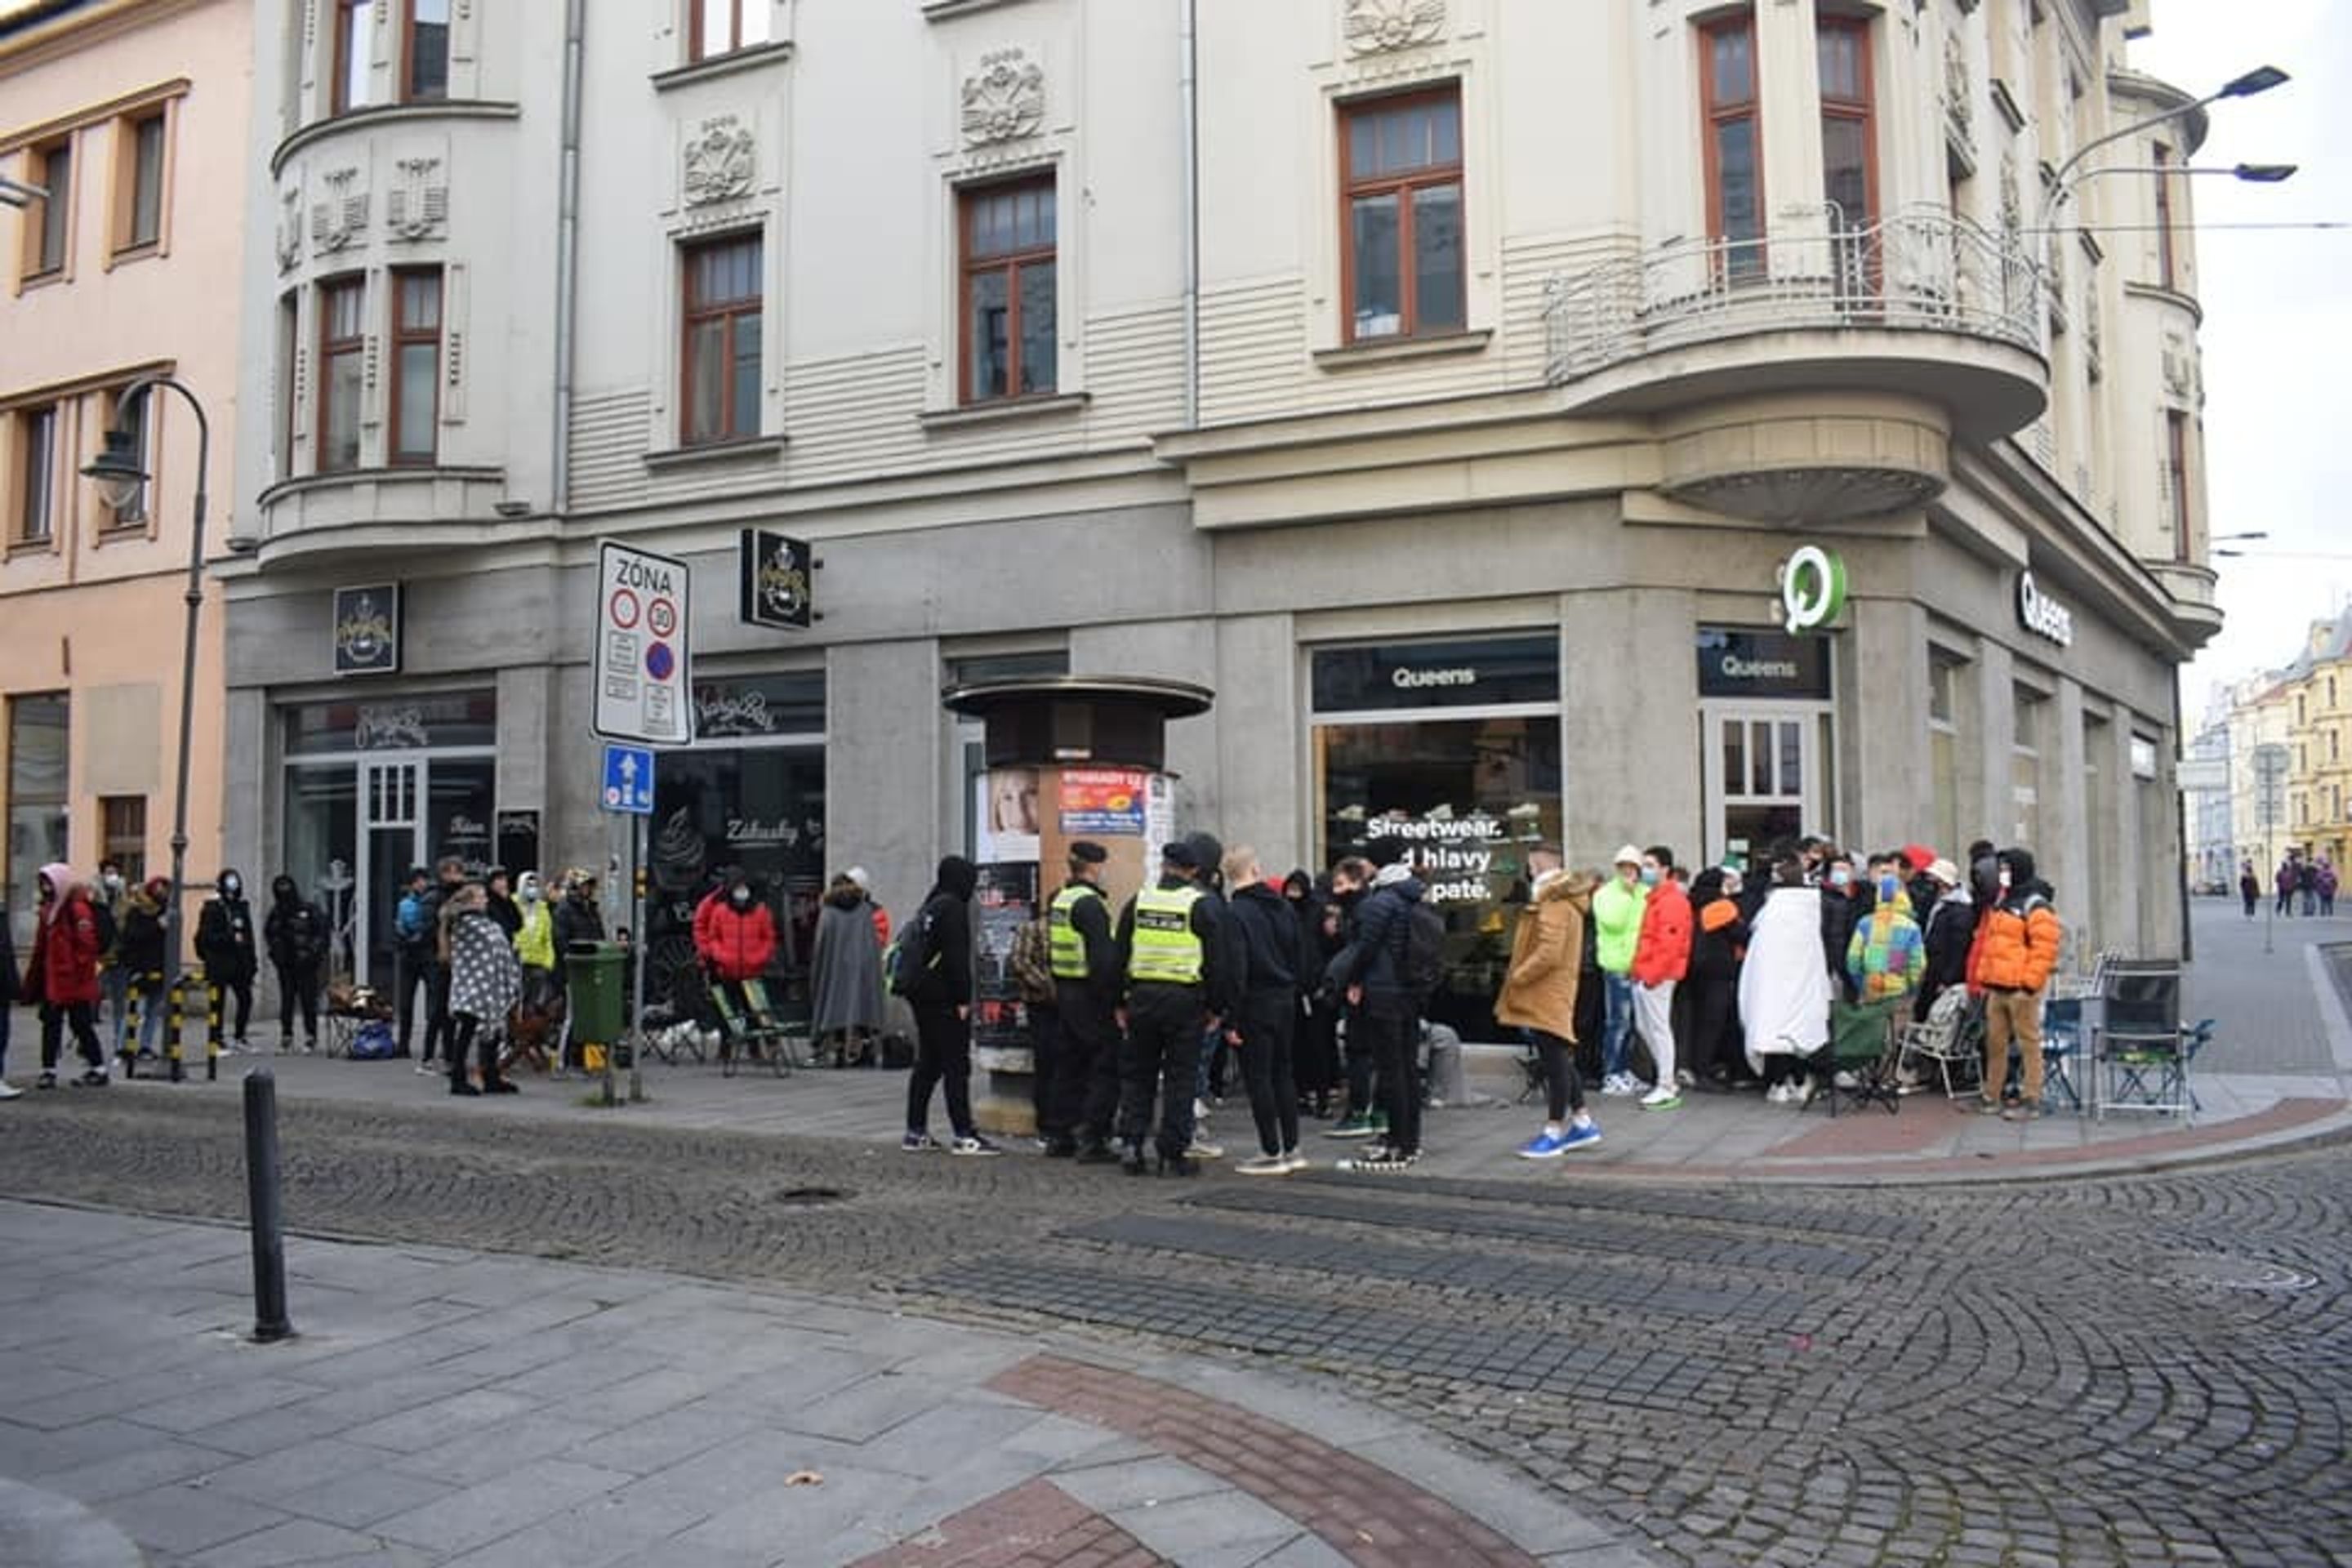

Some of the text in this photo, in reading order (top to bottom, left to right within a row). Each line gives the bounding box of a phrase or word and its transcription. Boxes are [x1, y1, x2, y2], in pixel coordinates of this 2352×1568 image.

[616, 557, 672, 593] ZÓNA
[656, 606, 669, 627] 30
[2021, 571, 2071, 646] Queens
[1392, 667, 1475, 687] Queens
[1722, 656, 1797, 676] Queens
[1367, 817, 1503, 839] Streetwear.
[1423, 845, 1491, 874] hlavy
